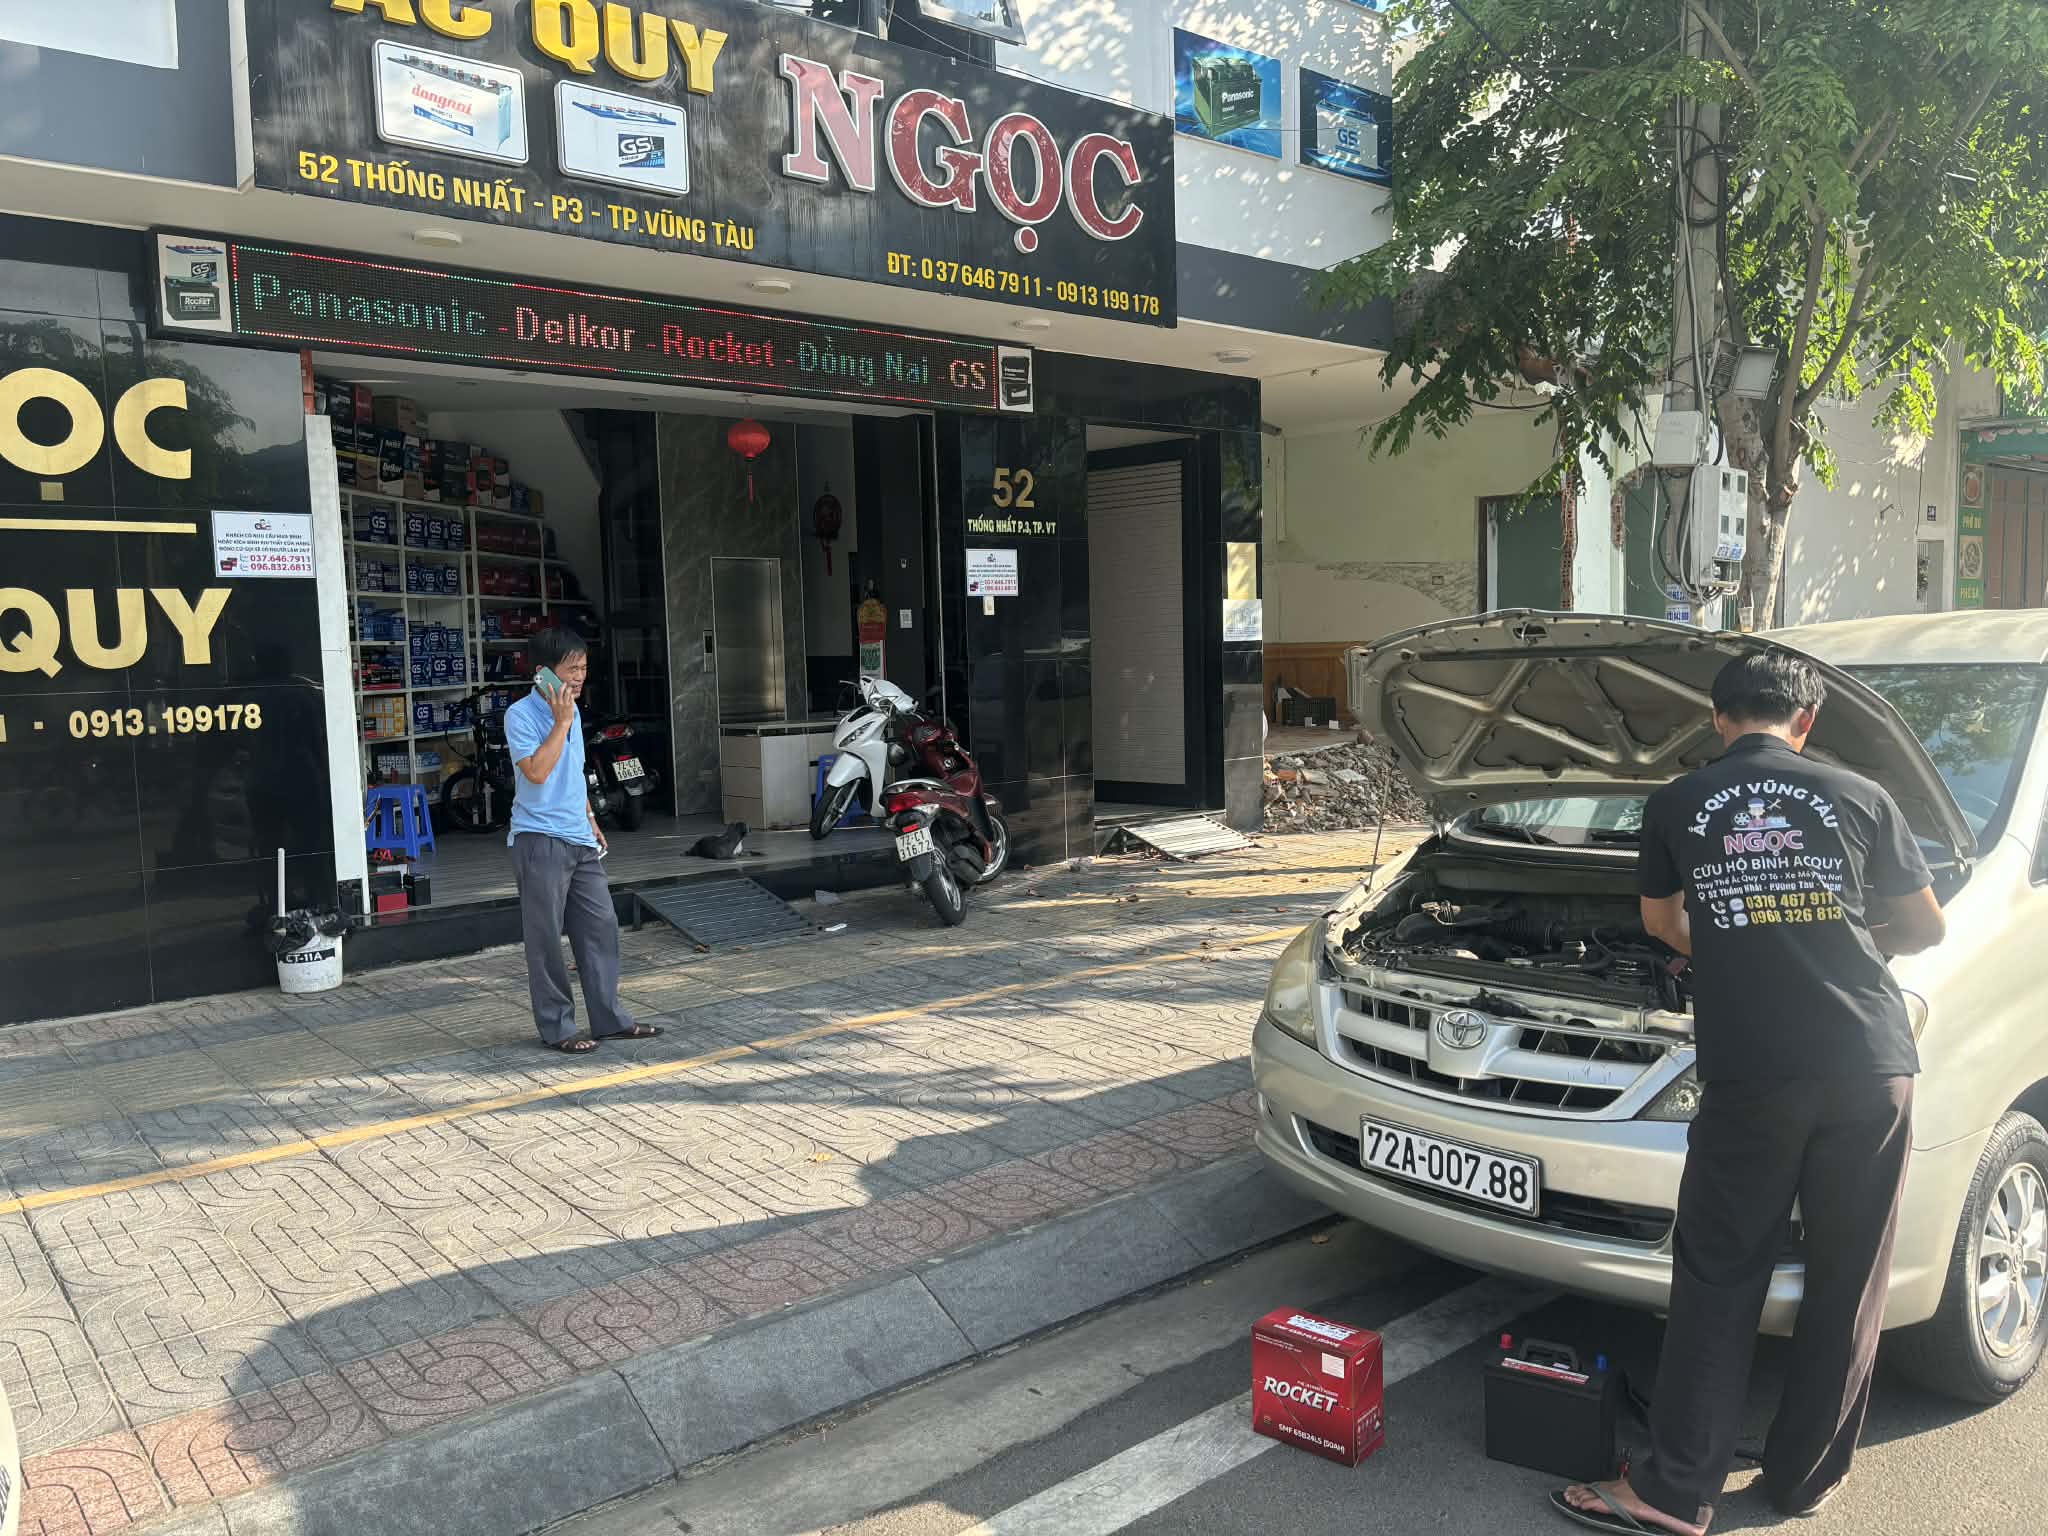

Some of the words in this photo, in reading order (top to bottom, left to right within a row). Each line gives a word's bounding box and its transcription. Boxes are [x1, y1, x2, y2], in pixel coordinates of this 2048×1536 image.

[532, 0, 728, 95] QUY
[1222, 89, 1254, 103] Panasonic
[620, 136, 651, 154] GS
[1337, 128, 1359, 146] GS
[780, 53, 1144, 254] NGỌC
[298, 150, 340, 184] 52
[346, 159, 445, 201] THỐNG
[453, 177, 526, 214] NHẤT
[552, 194, 584, 224] P3
[607, 204, 706, 243] TP.VŨNG
[712, 219, 755, 250] TÀU
[192, 263, 210, 275] GS
[887, 251, 917, 277] ĐT:
[252, 271, 489, 338] Panasonic
[885, 350, 928, 385] Nai
[992, 467, 1035, 508] 52
[371, 515, 387, 529] GS
[408, 518, 422, 533] GS
[429, 520, 441, 534] GS
[250, 555, 310, 563] 037.646.7911
[251, 564, 312, 572] 096.832.6813
[434, 660, 447, 672] GS
[452, 659, 464, 672] GS
[69, 703, 263, 739] 0913.199178
[417, 706, 429, 720] GS
[1704, 785, 1741, 811] QUY
[1746, 779, 1809, 800] VŨNG
[1808, 794, 1839, 829] TÀU
[900, 840, 932, 859] 316.72
[1723, 829, 1804, 856] NGỌC
[1726, 857, 1747, 873] HỘ
[1751, 855, 1789, 871] BÌNH
[1794, 855, 1843, 870] ACQUY
[1785, 871, 1796, 880] Xe
[1746, 894, 1777, 909] 0376
[1780, 893, 1805, 908] 467
[1809, 892, 1834, 905] 911
[1785, 908, 1813, 923] 326
[1817, 906, 1843, 921] 813
[286, 952, 323, 963] CT-11A
[1367, 1125, 1529, 1204] 72A-007.88
[1263, 1375, 1337, 1414] ROCKET
